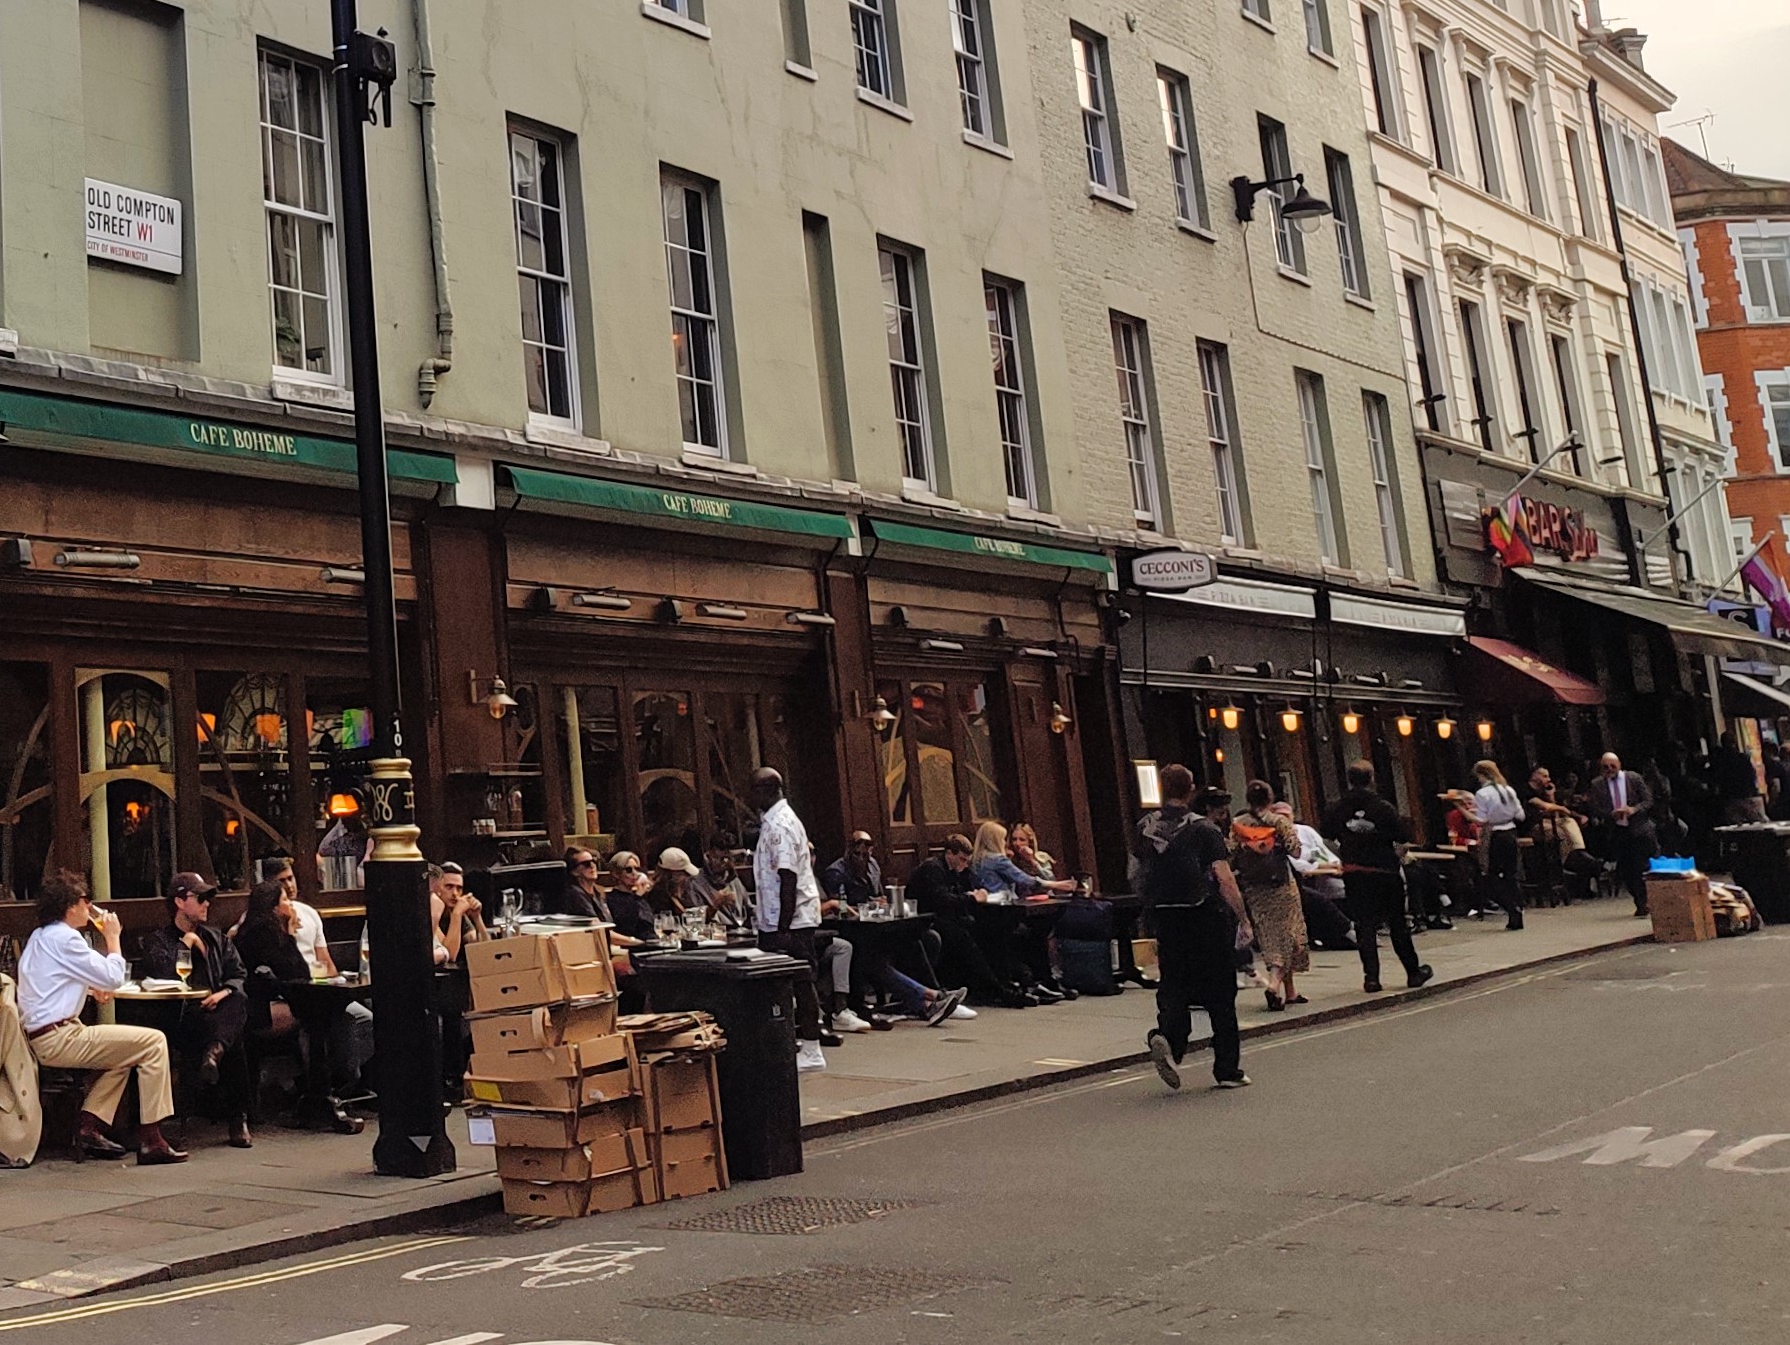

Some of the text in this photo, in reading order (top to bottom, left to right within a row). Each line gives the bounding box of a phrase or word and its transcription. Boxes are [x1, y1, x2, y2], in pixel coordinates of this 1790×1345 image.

[87, 187, 175, 226] OLD COMPTON
[87, 210, 153, 244] STREET W1
[87, 240, 149, 262] CITY OF WESTMINSTER
[190, 422, 298, 456] CAFE BOHEME
[662, 494, 732, 519] CAFE BOHEME
[1522, 497, 1562, 549] BAR
[1139, 558, 1205, 575] CECCONI'S
